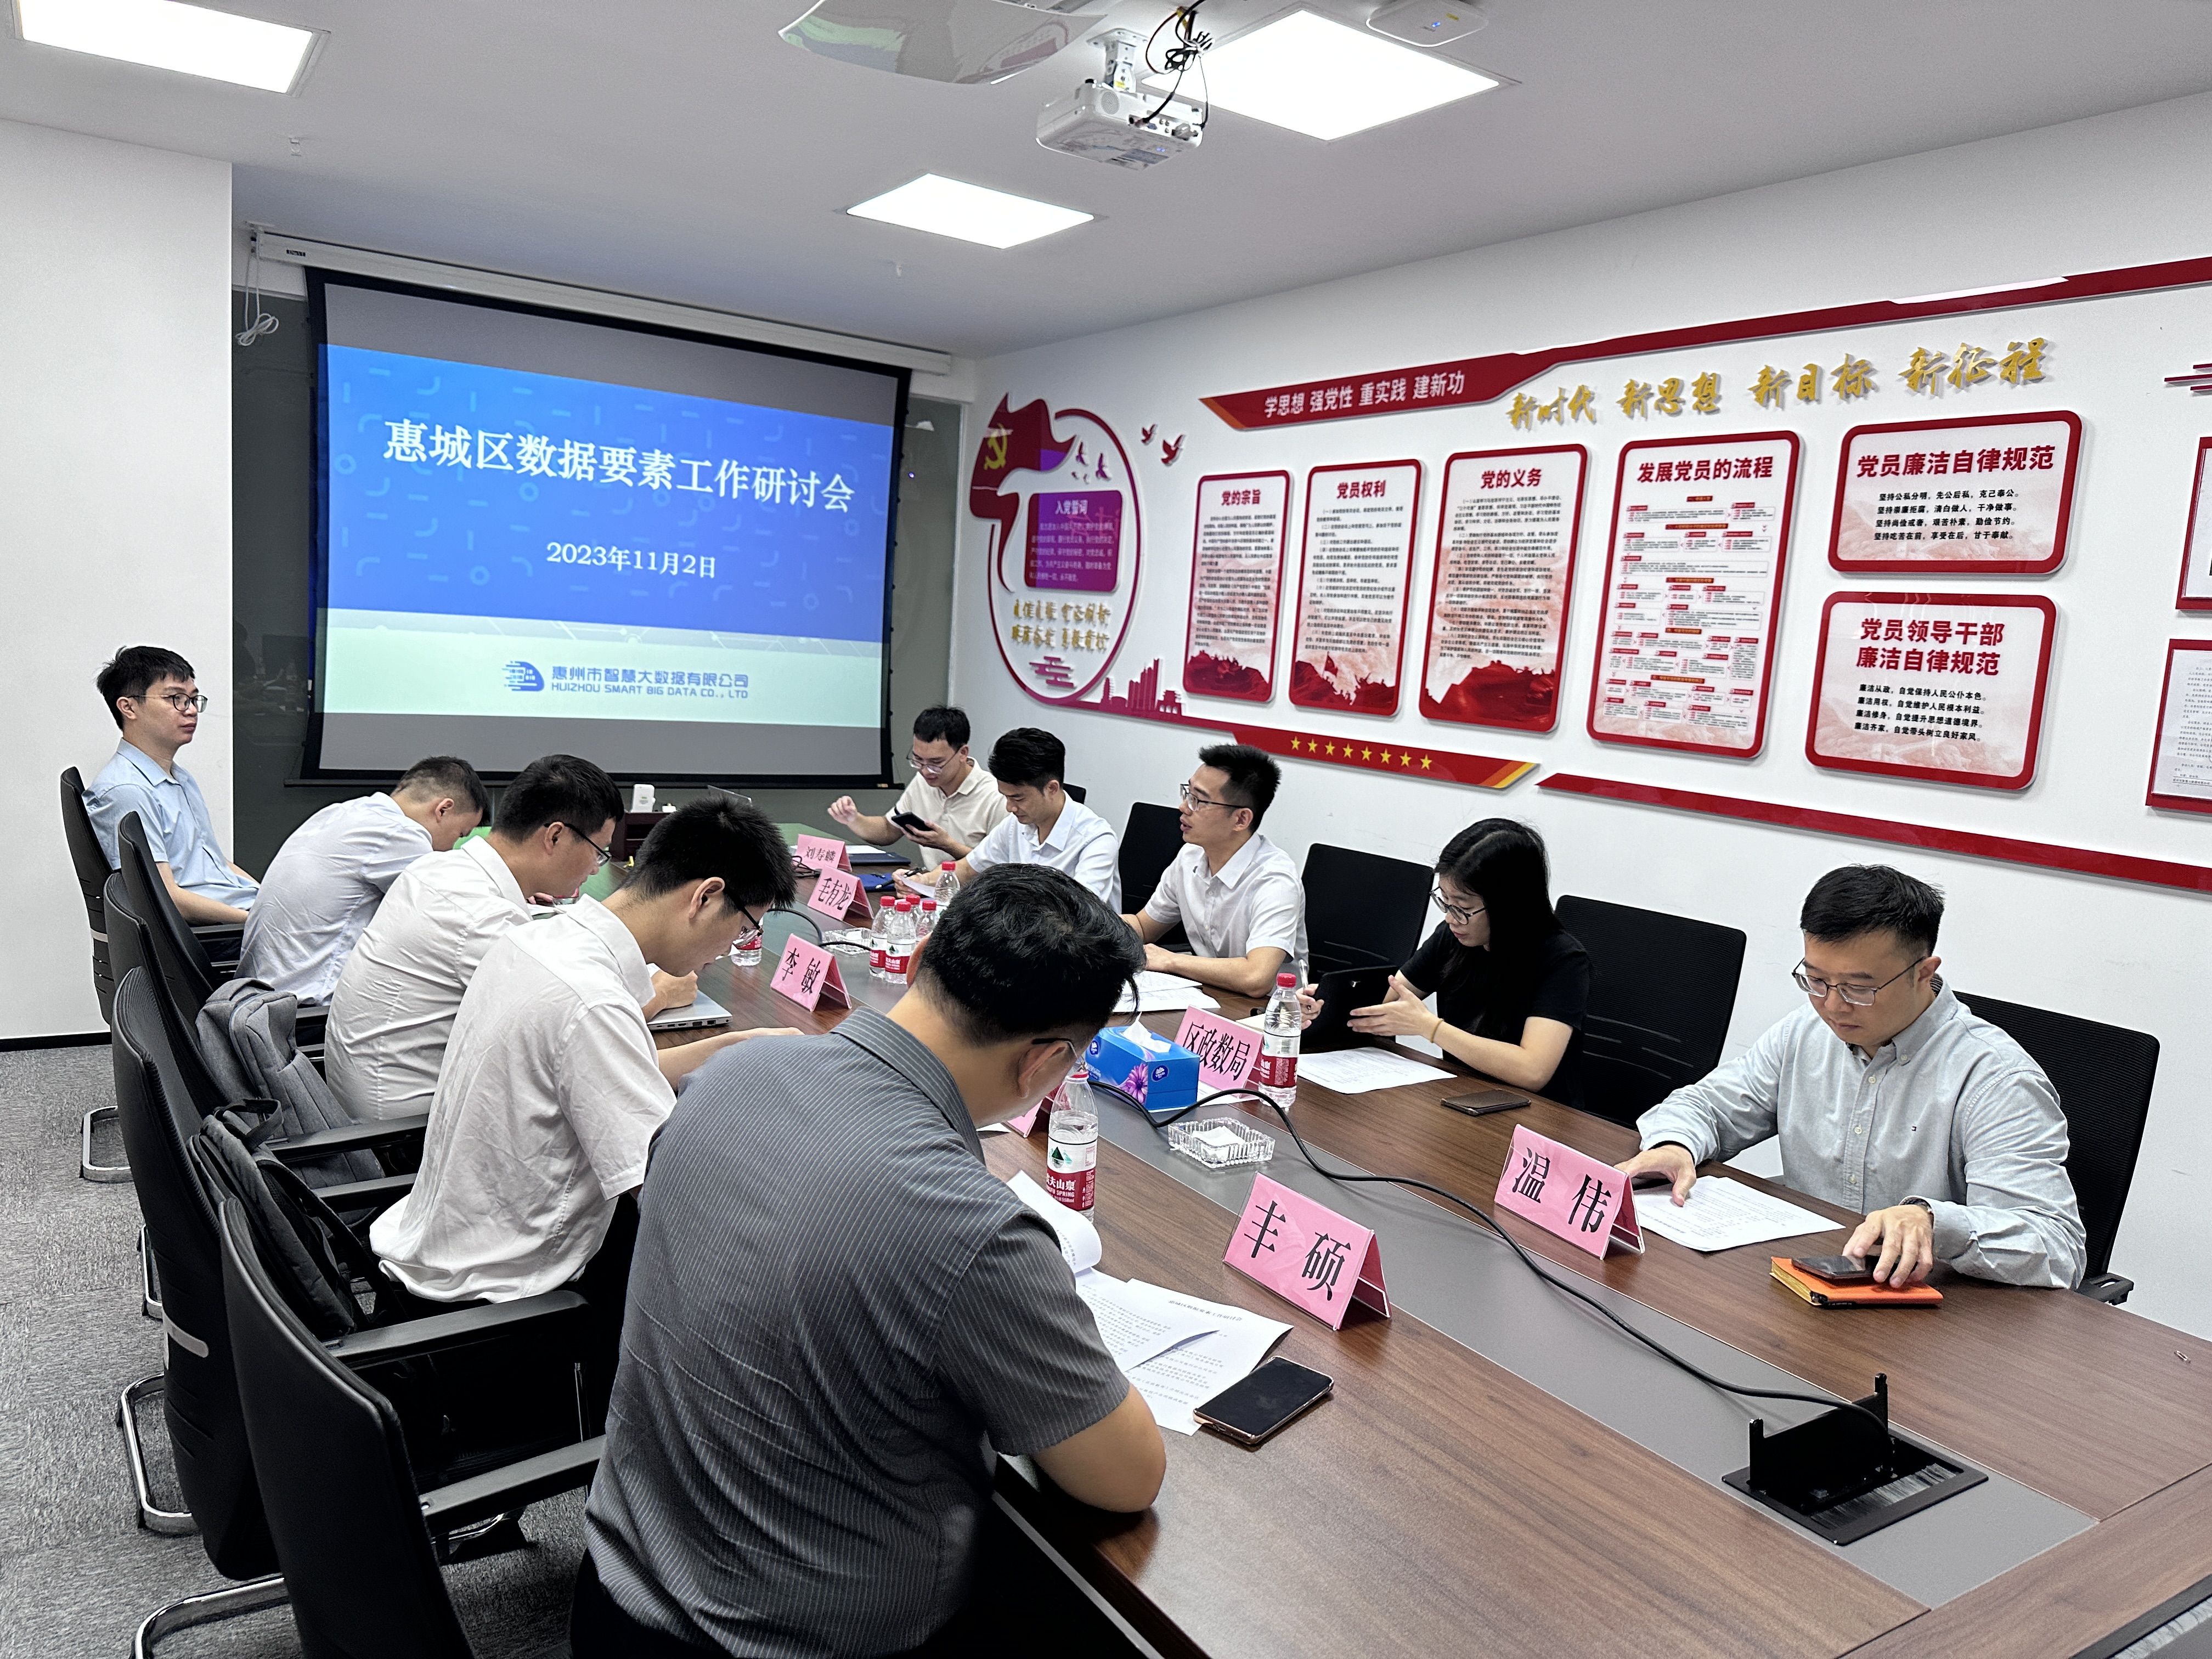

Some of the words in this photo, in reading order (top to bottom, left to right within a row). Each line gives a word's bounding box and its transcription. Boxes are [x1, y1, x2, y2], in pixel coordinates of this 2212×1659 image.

[1265, 392, 1305, 419] 学思想
[1310, 385, 1353, 413] 强党性
[1359, 378, 1407, 407] 重实践
[1413, 371, 1465, 400] 建新功
[1506, 385, 1594, 429] 新时代
[1617, 371, 1720, 419] 新思想
[1748, 353, 1875, 409] 新目标
[1898, 337, 2046, 393] 新征程
[383, 419, 855, 513] 惠城区数据要素工作研讨会
[1637, 456, 1774, 483] 发展党员的流程
[1857, 445, 2056, 477] 党员廉洁自律规范
[1336, 479, 1386, 499] 党员权利
[1480, 468, 1542, 489] 党的义务
[1221, 489, 1261, 506] 党的宗旨
[546, 541, 716, 579] 2023年11月2日
[1860, 618, 2005, 646] 党员领导干部
[551, 665, 749, 688] 惠州市智慧大数据有限公司
[1856, 646, 2001, 676] 廉洁自律规范
[551, 682, 601, 693] HUIZHOU
[605, 684, 642, 695] SMART
[647, 686, 664, 696] BIG
[668, 687, 697, 697] DATA
[729, 690, 748, 699] LTD
[805, 846, 837, 864] 刘寿麟
[818, 877, 851, 911] 毛有龙
[1182, 1021, 1251, 1081] 区政数局
[1512, 1147, 1612, 1233] 温伟
[1244, 1200, 1352, 1302] 丰硕
